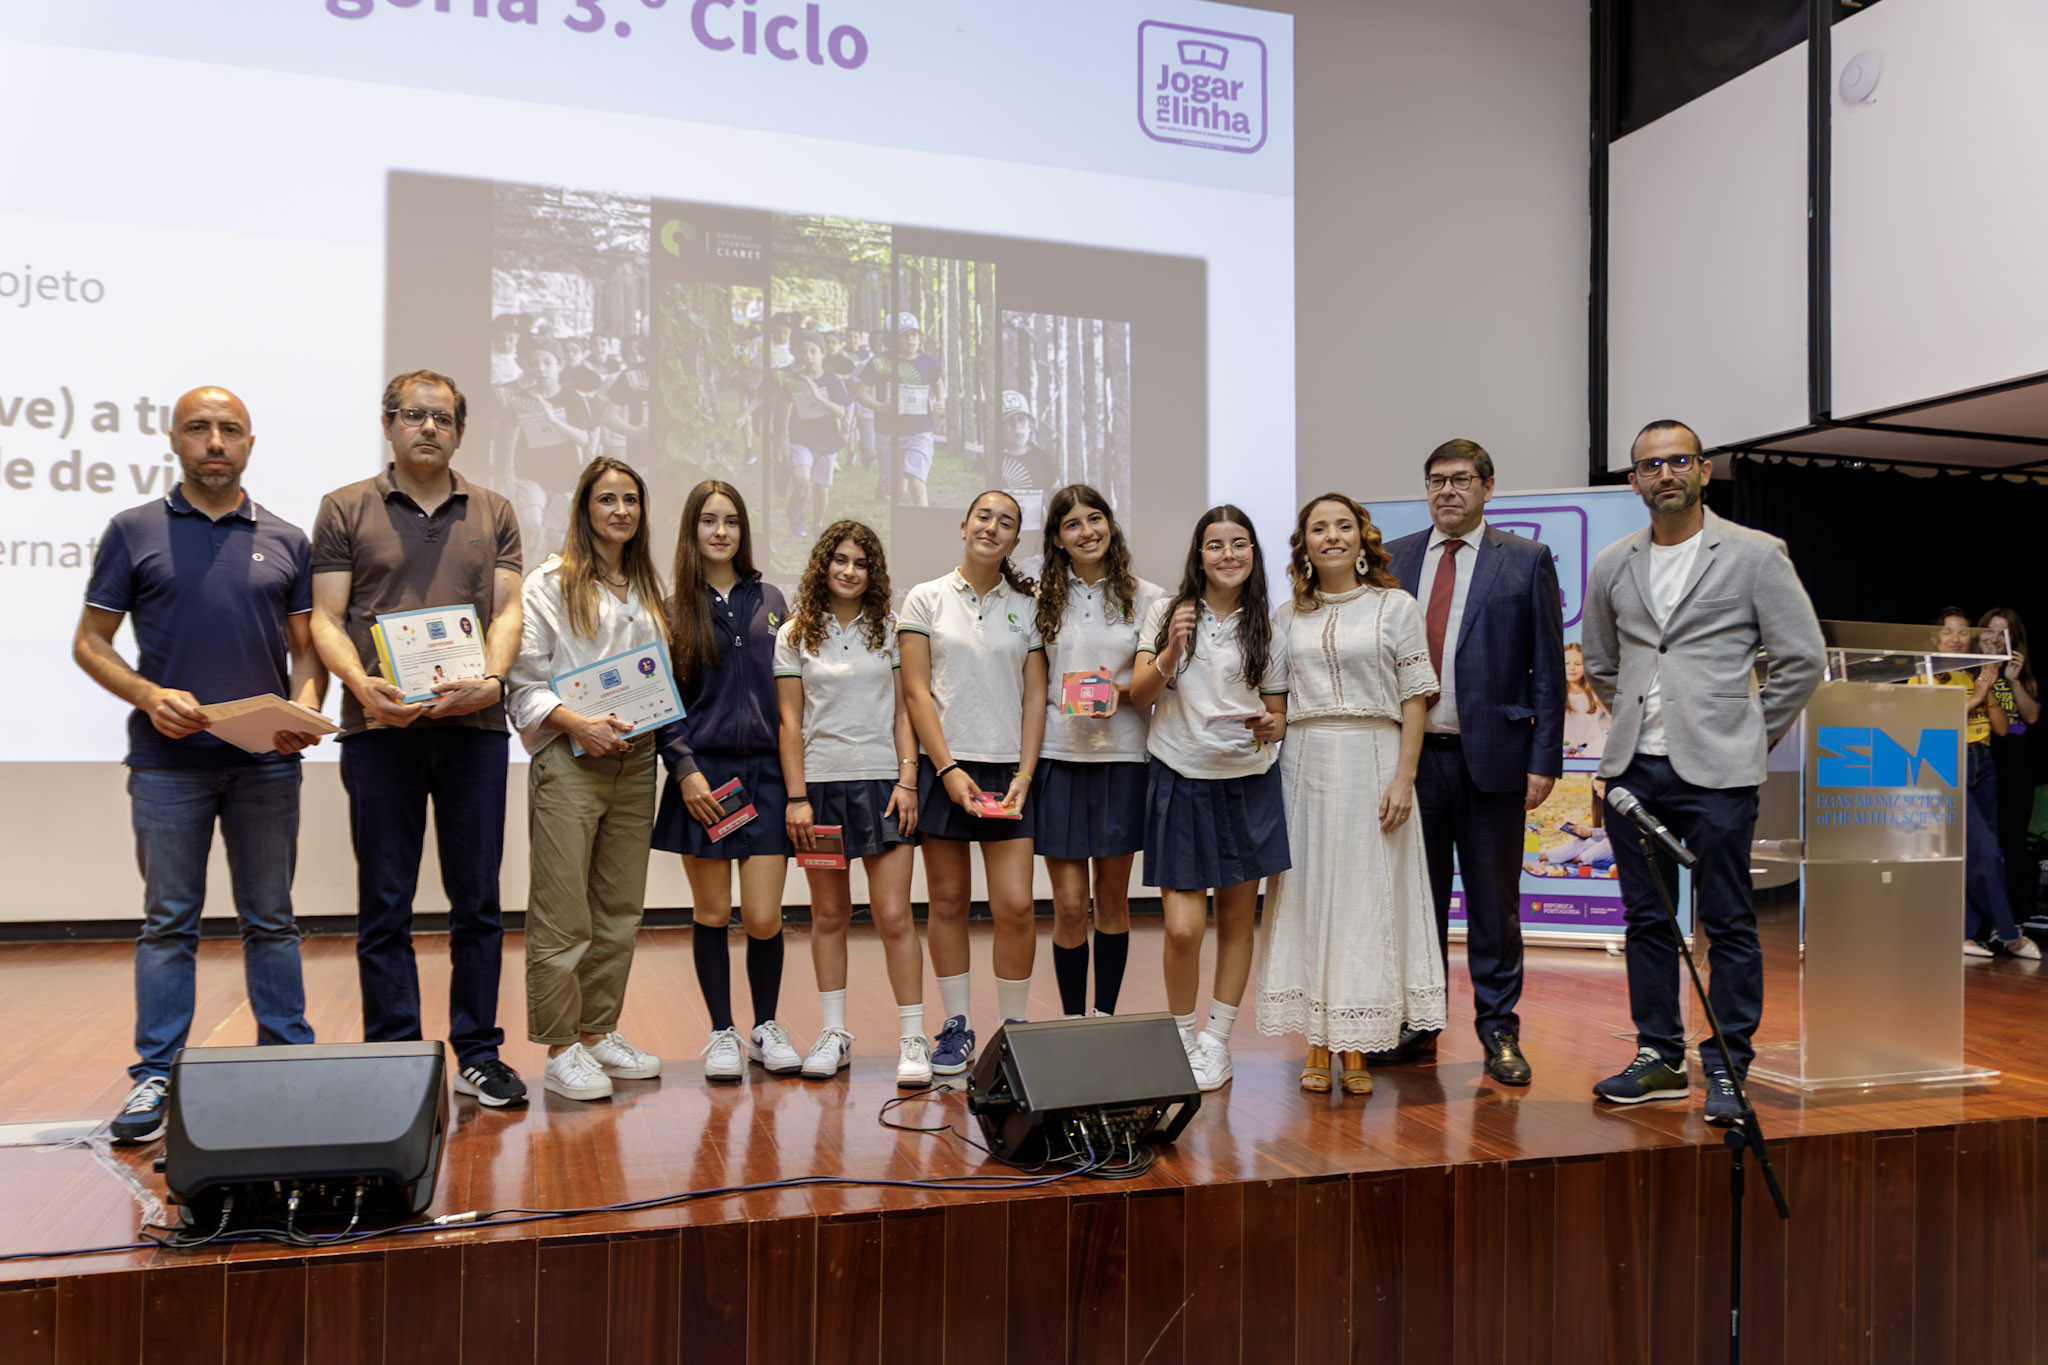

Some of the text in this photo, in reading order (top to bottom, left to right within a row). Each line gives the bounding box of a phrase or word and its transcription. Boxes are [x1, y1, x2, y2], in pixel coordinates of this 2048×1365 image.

[690, 0, 869, 70] Ciclo
[1156, 64, 1244, 104] Jogar
[1156, 94, 1170, 123] na
[1172, 96, 1251, 135] linha
[716, 247, 761, 260] CLARET
[91, 401, 120, 432] a
[49, 449, 116, 494] de
[128, 453, 178, 496] vi
[1816, 795, 1956, 809] EGAS MONIZ SCHOOL
[1816, 811, 1958, 825] of HEALTH & SCIENCE
